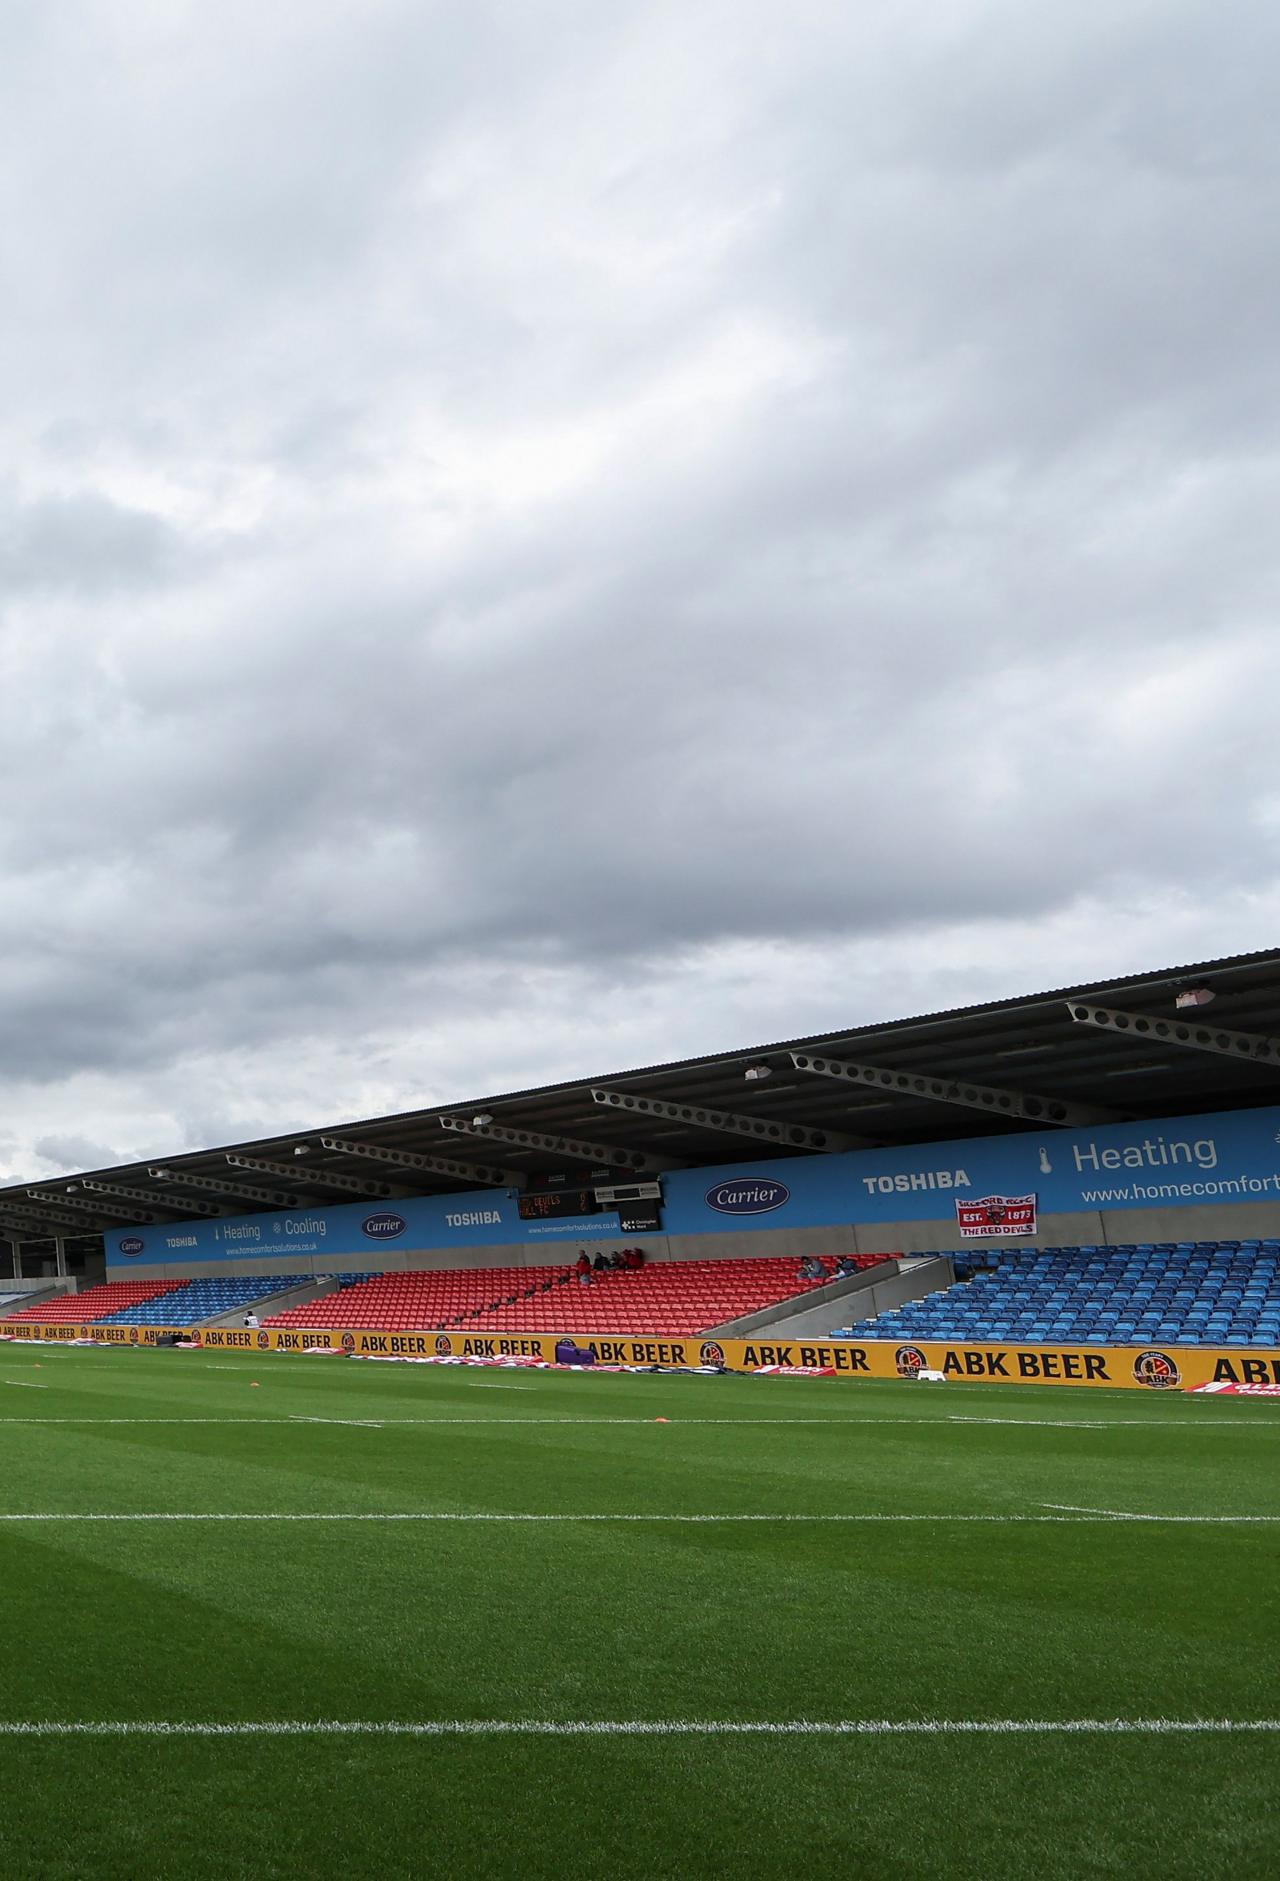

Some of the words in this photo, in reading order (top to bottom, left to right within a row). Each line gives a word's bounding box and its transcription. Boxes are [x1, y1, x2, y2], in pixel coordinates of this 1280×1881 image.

[1073, 1137, 1218, 1172] Heating
[863, 1169, 971, 1194] TOSHIBA
[716, 1186, 778, 1205] Carrier
[446, 1210, 502, 1227] TOSHIBA
[963, 1213, 983, 1222] EST.
[1008, 1210, 1031, 1220] 1873
[224, 1224, 260, 1241] Heating
[285, 1217, 327, 1236] Cooling
[366, 1220, 401, 1233] Carrier
[962, 1228, 980, 1236] THE
[980, 1226, 1002, 1235] RED
[121, 1241, 141, 1251] Carrier
[167, 1236, 198, 1248] TOSHIBA
[4, 1326, 15, 1335] ABK
[16, 1327, 30, 1337] BEER
[45, 1327, 58, 1338] ABK
[58, 1328, 75, 1339] BEER
[91, 1328, 105, 1340] ABK
[107, 1329, 125, 1341] BEER
[205, 1332, 224, 1345] ABK
[226, 1332, 251, 1347] BEER
[277, 1334, 299, 1348] ABK
[302, 1334, 331, 1348] BEER
[361, 1336, 388, 1351] ABK
[391, 1337, 426, 1354] BEER
[463, 1339, 495, 1355] ABK
[500, 1339, 543, 1357] BEER
[590, 1342, 628, 1361] ABK
[633, 1343, 687, 1364] BEER
[743, 1346, 793, 1367] ABK
[801, 1347, 871, 1371] BEER
[943, 1352, 1011, 1377] ABK
[1018, 1353, 1112, 1380] BEER
